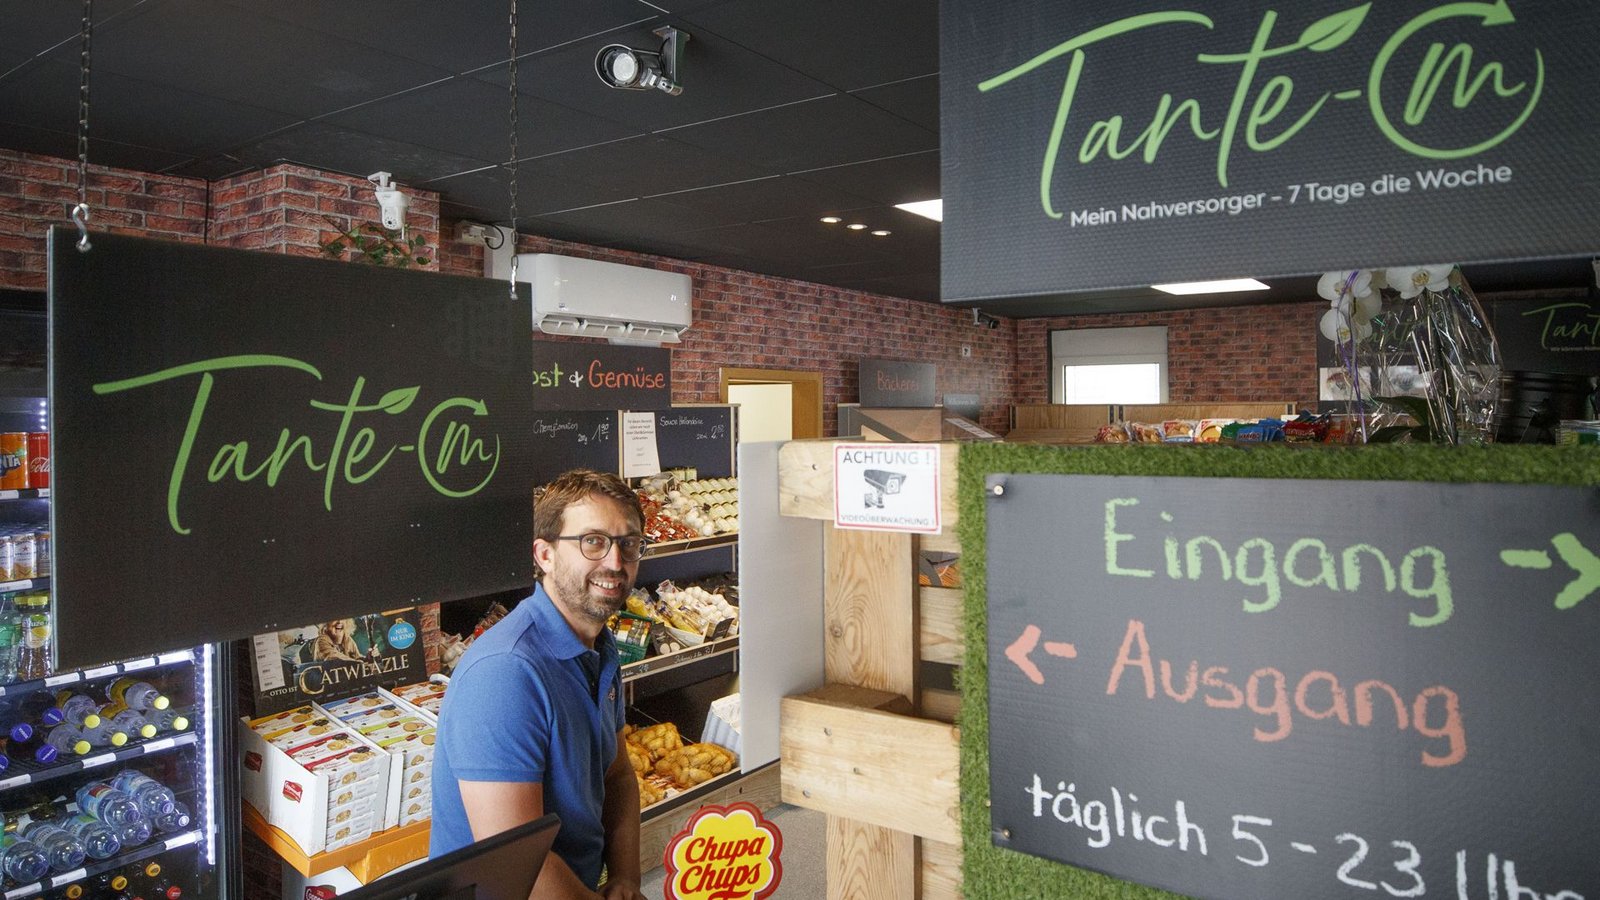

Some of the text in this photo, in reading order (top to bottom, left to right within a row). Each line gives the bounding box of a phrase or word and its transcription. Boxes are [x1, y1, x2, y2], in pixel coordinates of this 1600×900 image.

[1070, 209, 1118, 228] Mein
[1121, 190, 1264, 221] Nahversorger
[1288, 184, 1302, 205] 7
[1305, 180, 1366, 203] Tage
[1371, 173, 1411, 196] die
[1415, 163, 1513, 192] Woche
[588, 359, 666, 388] Gemüse
[843, 450, 919, 465] ACHTUNG
[841, 514, 929, 526] VIDEOÜBERWACHUNG
[1104, 497, 1454, 628] Eingang
[270, 687, 288, 697] OTTO
[288, 685, 298, 694] IST
[298, 653, 410, 696] CATWEAZLE
[1106, 620, 1467, 768] Ausgang
[685, 835, 766, 867] Chupa
[1025, 774, 1208, 856] täglich
[1232, 815, 1273, 867] 5
[1335, 832, 1426, 898] 23
[680, 862, 762, 895] Chups
